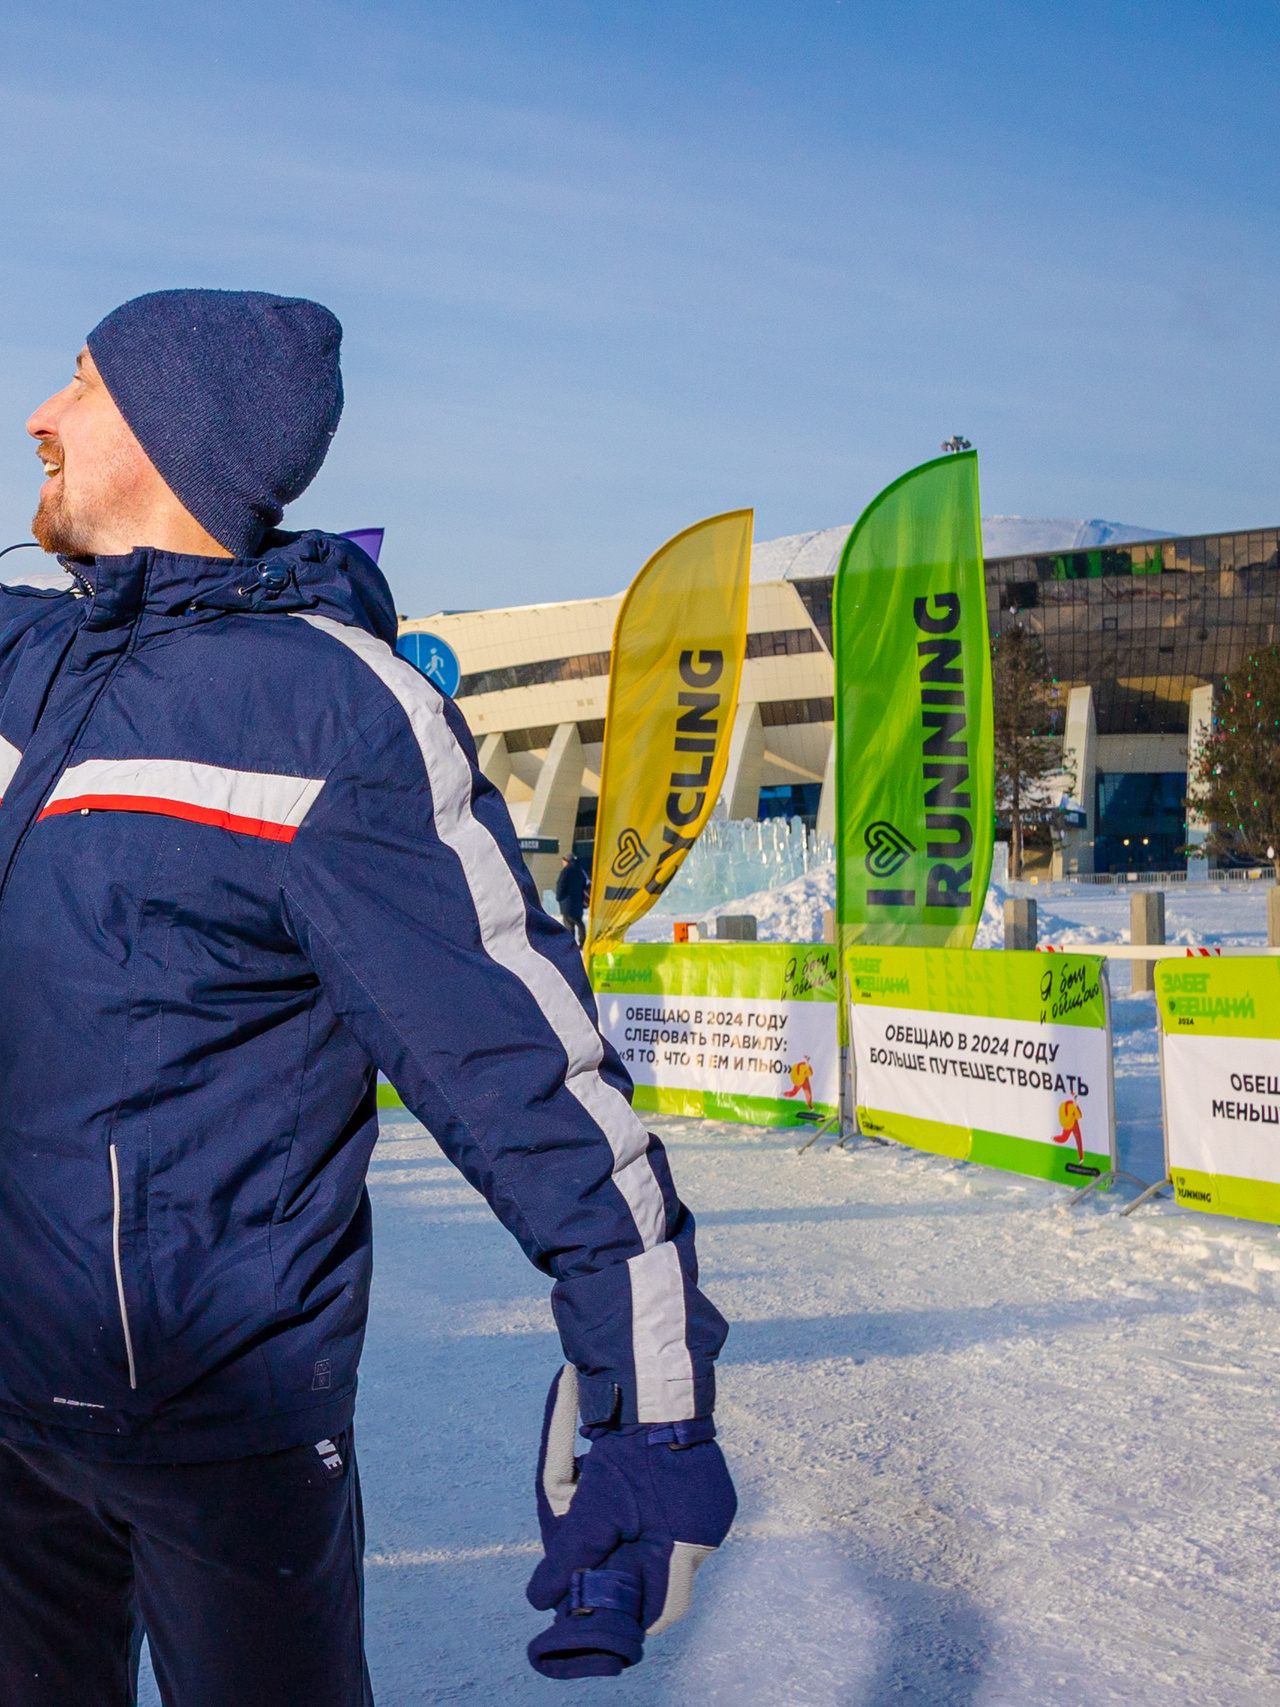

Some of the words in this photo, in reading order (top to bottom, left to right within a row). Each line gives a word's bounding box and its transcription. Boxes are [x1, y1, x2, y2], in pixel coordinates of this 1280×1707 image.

[914, 592, 972, 908] RUNNING
[646, 649, 724, 896] CYCLING
[867, 890, 916, 906] I
[1041, 971, 1053, 1001] Я
[625, 1007, 690, 1026] ОБЕЩАЮ
[694, 1010, 703, 1024] В
[707, 1011, 743, 1027] 2024
[748, 1013, 788, 1031] ГОДУ
[625, 1027, 707, 1046] СЛЕДОВАТЬ
[712, 1033, 788, 1052] ПРАВИЛУ:
[885, 1024, 954, 1049] ОБЕЩАЮ
[958, 1033, 968, 1050] В
[971, 1035, 1009, 1056] 2024
[1013, 1040, 1060, 1065] ГОДУ
[638, 1050, 660, 1067] ТО,
[664, 1052, 690, 1066] ЧТО
[696, 1054, 704, 1067] Я
[709, 1055, 728, 1069] ЕМ
[734, 1057, 743, 1071] И
[748, 1058, 792, 1075] ПЬЮ»
[870, 1047, 926, 1072] БОЛЬШЕ
[929, 1056, 1089, 1096] ПУТЕШЕСТВОВАТЬ
